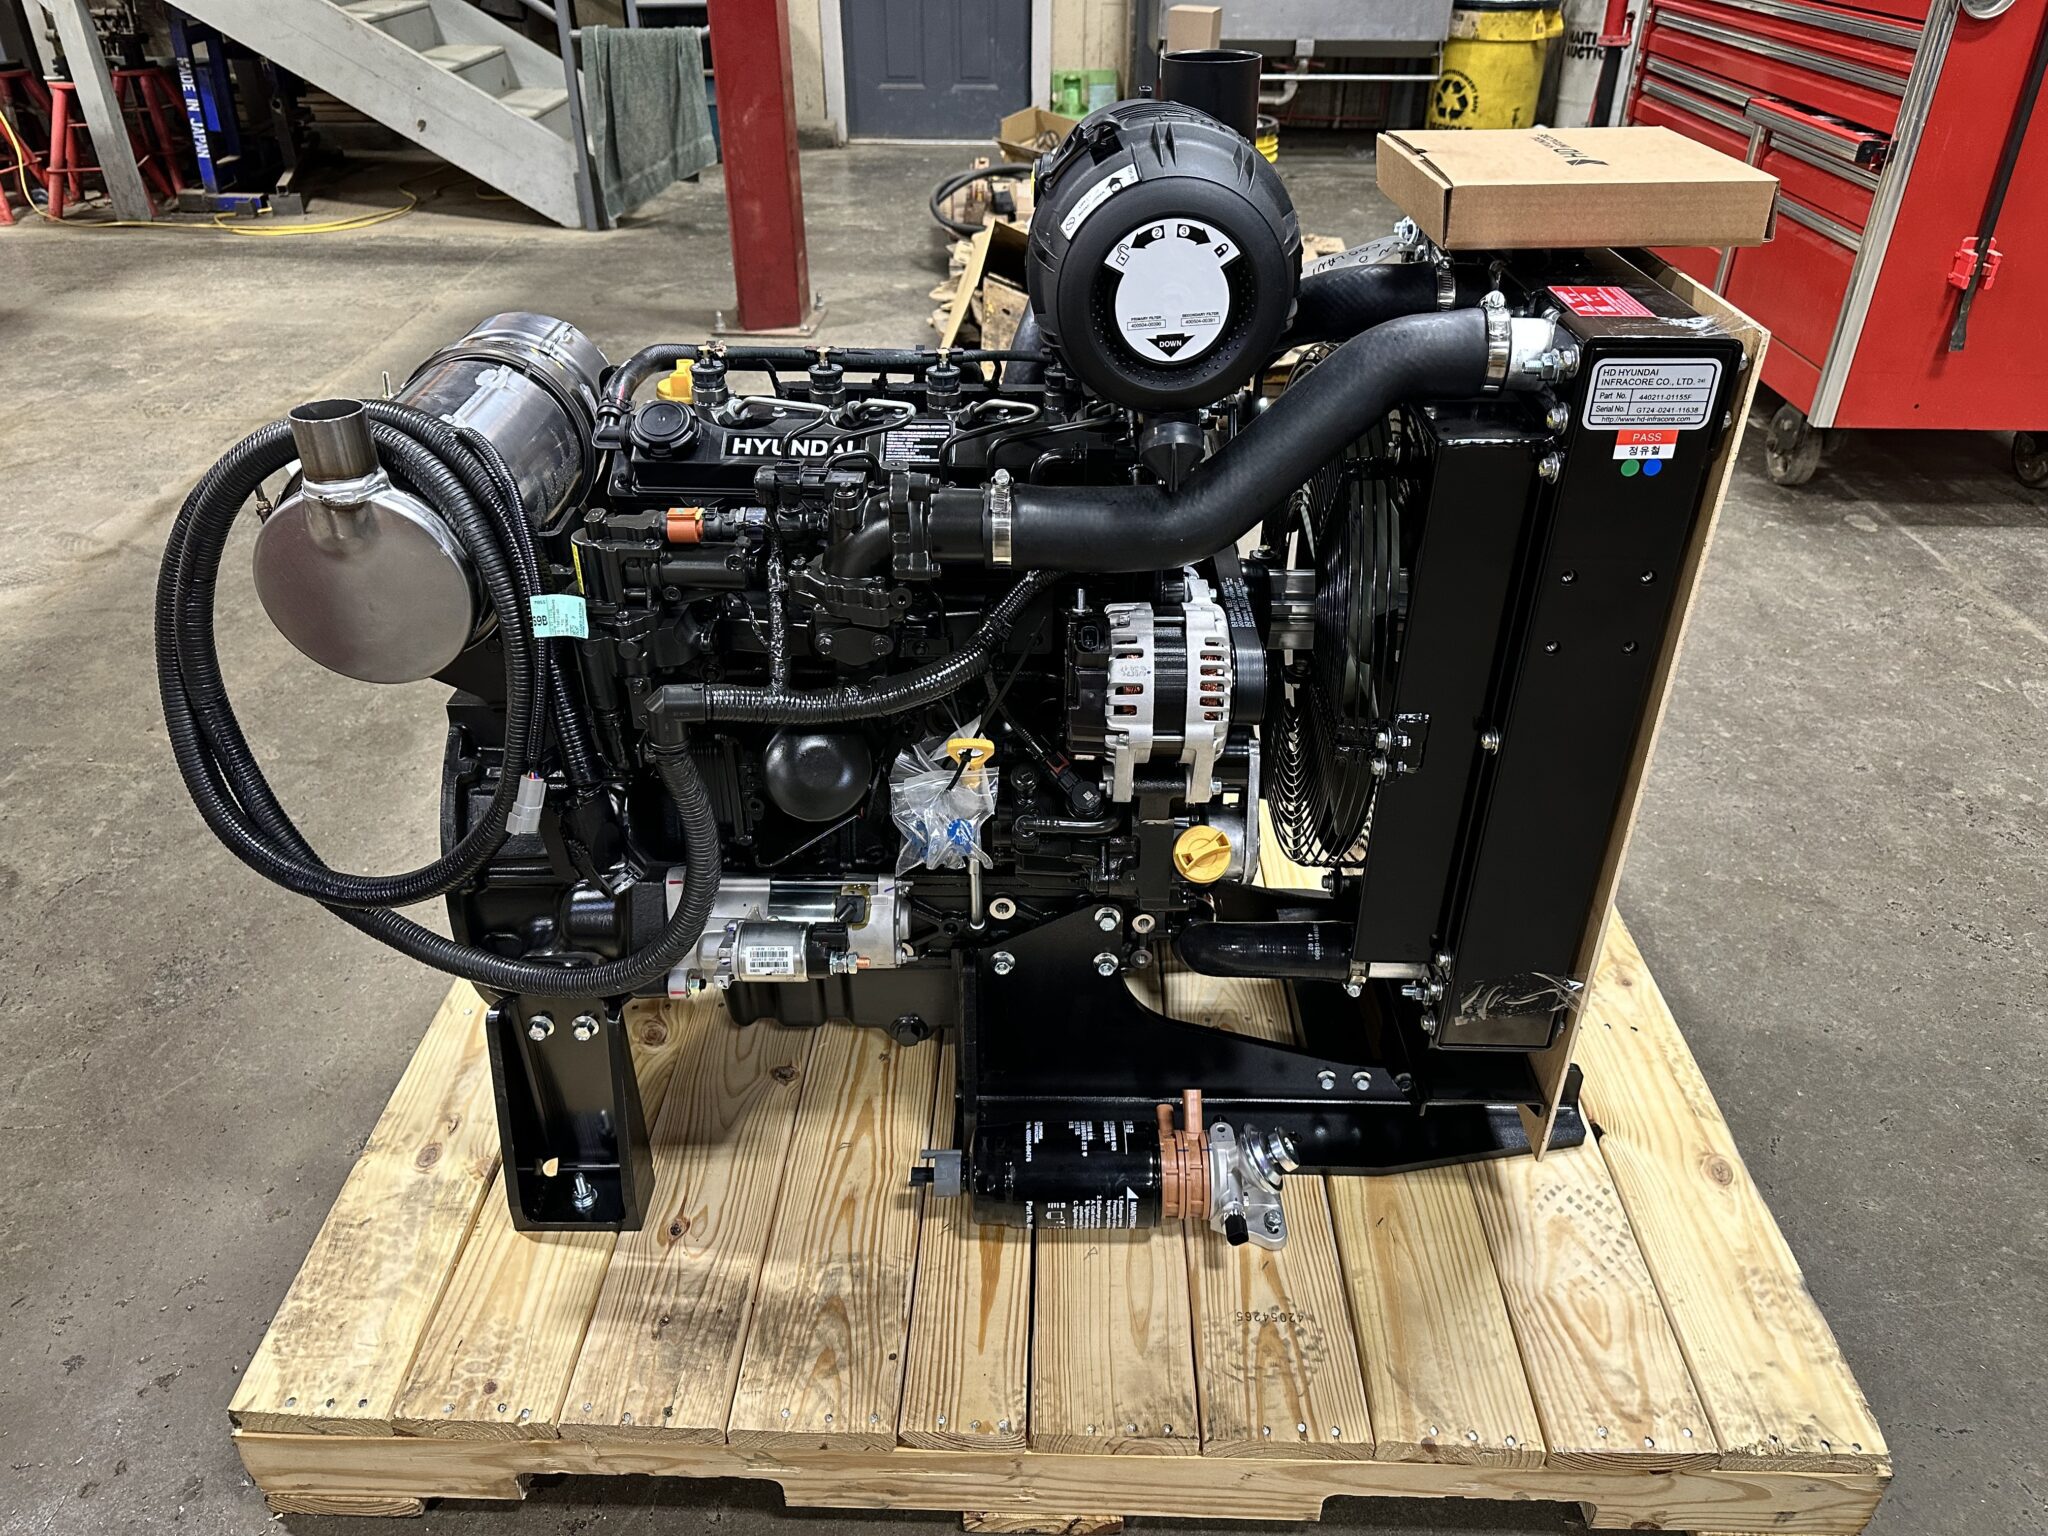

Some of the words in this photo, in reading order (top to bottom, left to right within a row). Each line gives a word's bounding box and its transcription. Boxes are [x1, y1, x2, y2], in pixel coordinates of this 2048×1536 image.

[185, 98, 201, 112] IN
[189, 117, 211, 158] JAPAN
[1159, 340, 1182, 348] DOWN
[1601, 378, 1655, 386] INFRACORE
[1656, 378, 1675, 387] CO.,
[1677, 378, 1696, 386] LTD.
[1599, 392, 1613, 400] Part
[1596, 405, 1614, 413] Serial
[1632, 433, 1662, 442] PASS
[1025, 1201, 1033, 1214] Part
[1236, 1311, 1304, 1322] 42054265
